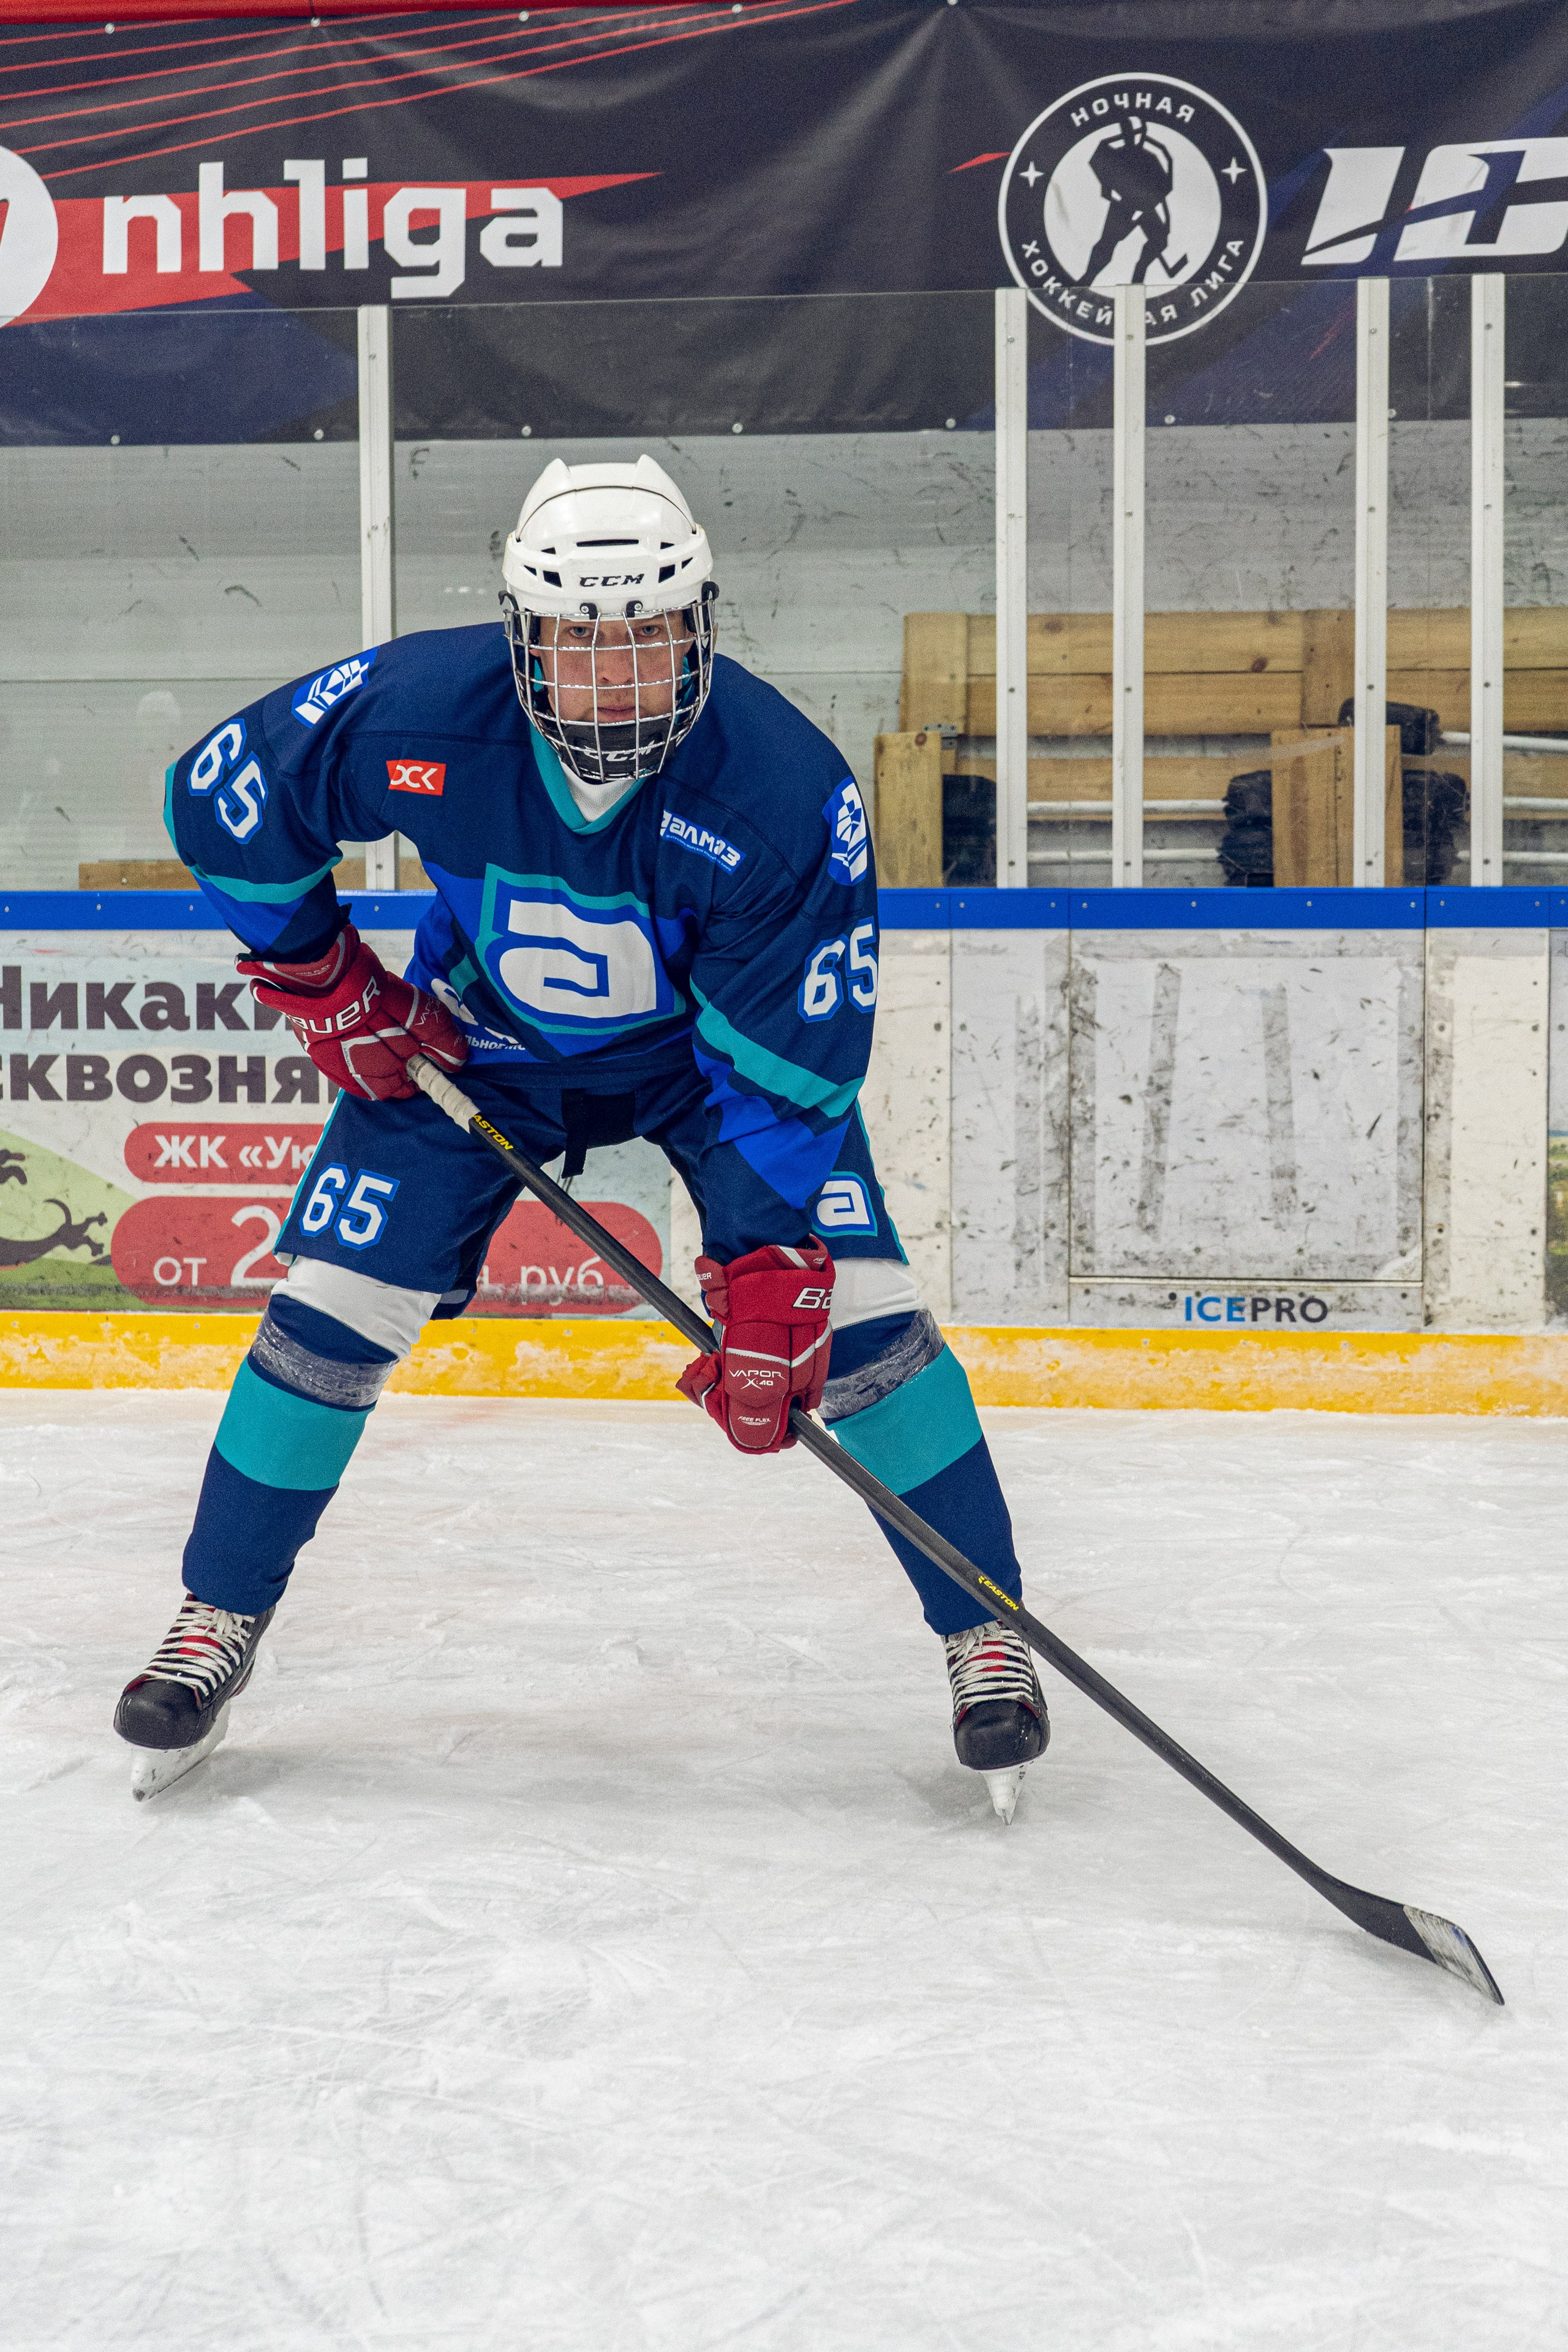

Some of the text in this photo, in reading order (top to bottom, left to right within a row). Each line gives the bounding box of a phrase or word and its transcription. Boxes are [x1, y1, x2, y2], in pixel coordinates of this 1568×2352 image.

[1071, 92, 1196, 127] НОЧНАЯ
[1022, 239, 1245, 325] ХОККЕЙАЯ ЛИГА
[579, 573, 645, 587] CCM
[583, 739, 655, 762] CCM
[187, 718, 268, 844] 65
[798, 916, 878, 1023] 65
[280, 975, 381, 1034] AUER
[0, 1054, 341, 1104] квозня
[473, 1114, 514, 1150] ASTON
[153, 1134, 228, 1169] ЖК
[299, 1163, 400, 1251] 65
[153, 1257, 206, 1286] от
[520, 1256, 604, 1306] руб
[697, 1272, 712, 1281] AUER
[1185, 1296, 1329, 1324] ICEPRO
[728, 1369, 786, 1380] VAPOR
[983, 1580, 1020, 1611] EASTON
